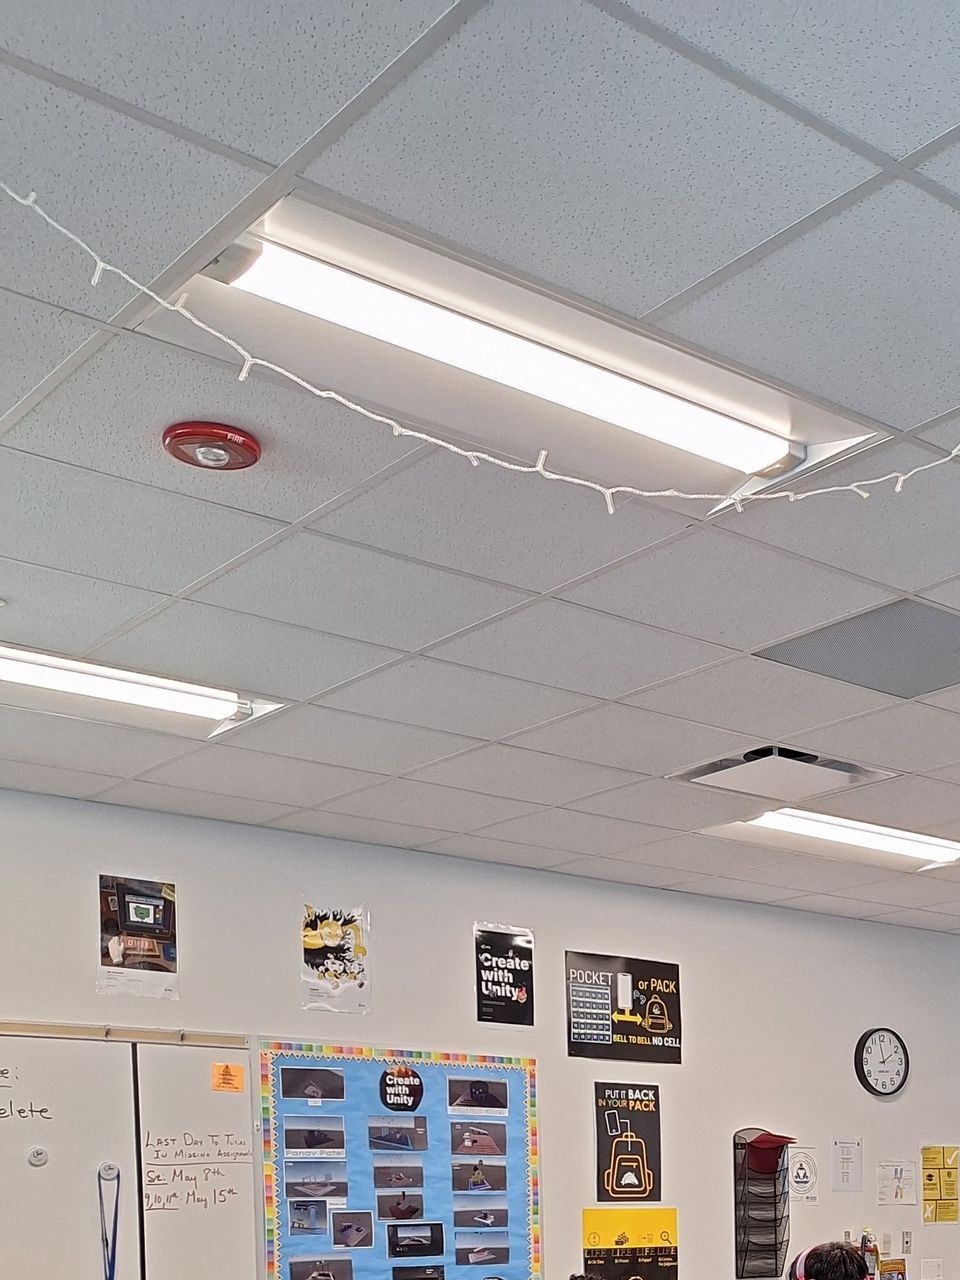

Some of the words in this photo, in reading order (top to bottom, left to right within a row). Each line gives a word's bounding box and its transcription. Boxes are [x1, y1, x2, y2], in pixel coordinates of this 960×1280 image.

[227, 433, 244, 444] FIRE
[480, 952, 530, 971] Create
[481, 968, 514, 983] with
[569, 969, 613, 986] POCKET
[481, 981, 519, 1001] Unity
[638, 980, 648, 989] or
[650, 978, 677, 993] PACK
[613, 1034, 628, 1043] BELL
[628, 1035, 637, 1044] TO
[637, 1036, 652, 1045] BELL
[652, 1037, 663, 1046] NO
[663, 1037, 681, 1047] CELL
[871, 1037, 876, 1045] 11
[879, 1034, 885, 1042] 12
[865, 1046, 872, 1054] 10
[894, 1045, 899, 1053] 2
[863, 1057, 868, 1066] 9
[897, 1057, 903, 1065] 3
[867, 1069, 872, 1077] 8
[895, 1069, 901, 1077] 4
[386, 1075, 420, 1086] Create
[874, 1078, 878, 1087] 7
[881, 1081, 887, 1089] 6
[890, 1077, 895, 1086] 5
[386, 1085, 409, 1094] with
[605, 1089, 619, 1099] PUT
[621, 1090, 627, 1099] IT
[628, 1089, 656, 1100] BACK
[386, 1094, 414, 1106] Unity
[598, 1098, 606, 1107] IN
[607, 1099, 628, 1108] YOUR
[628, 1100, 656, 1112] PACK
[145, 1131, 177, 1148] LAST
[172, 1168, 197, 1190] May
[203, 1168, 225, 1181] 8th
[186, 1190, 208, 1209] May
[213, 1188, 238, 1205] 15th
